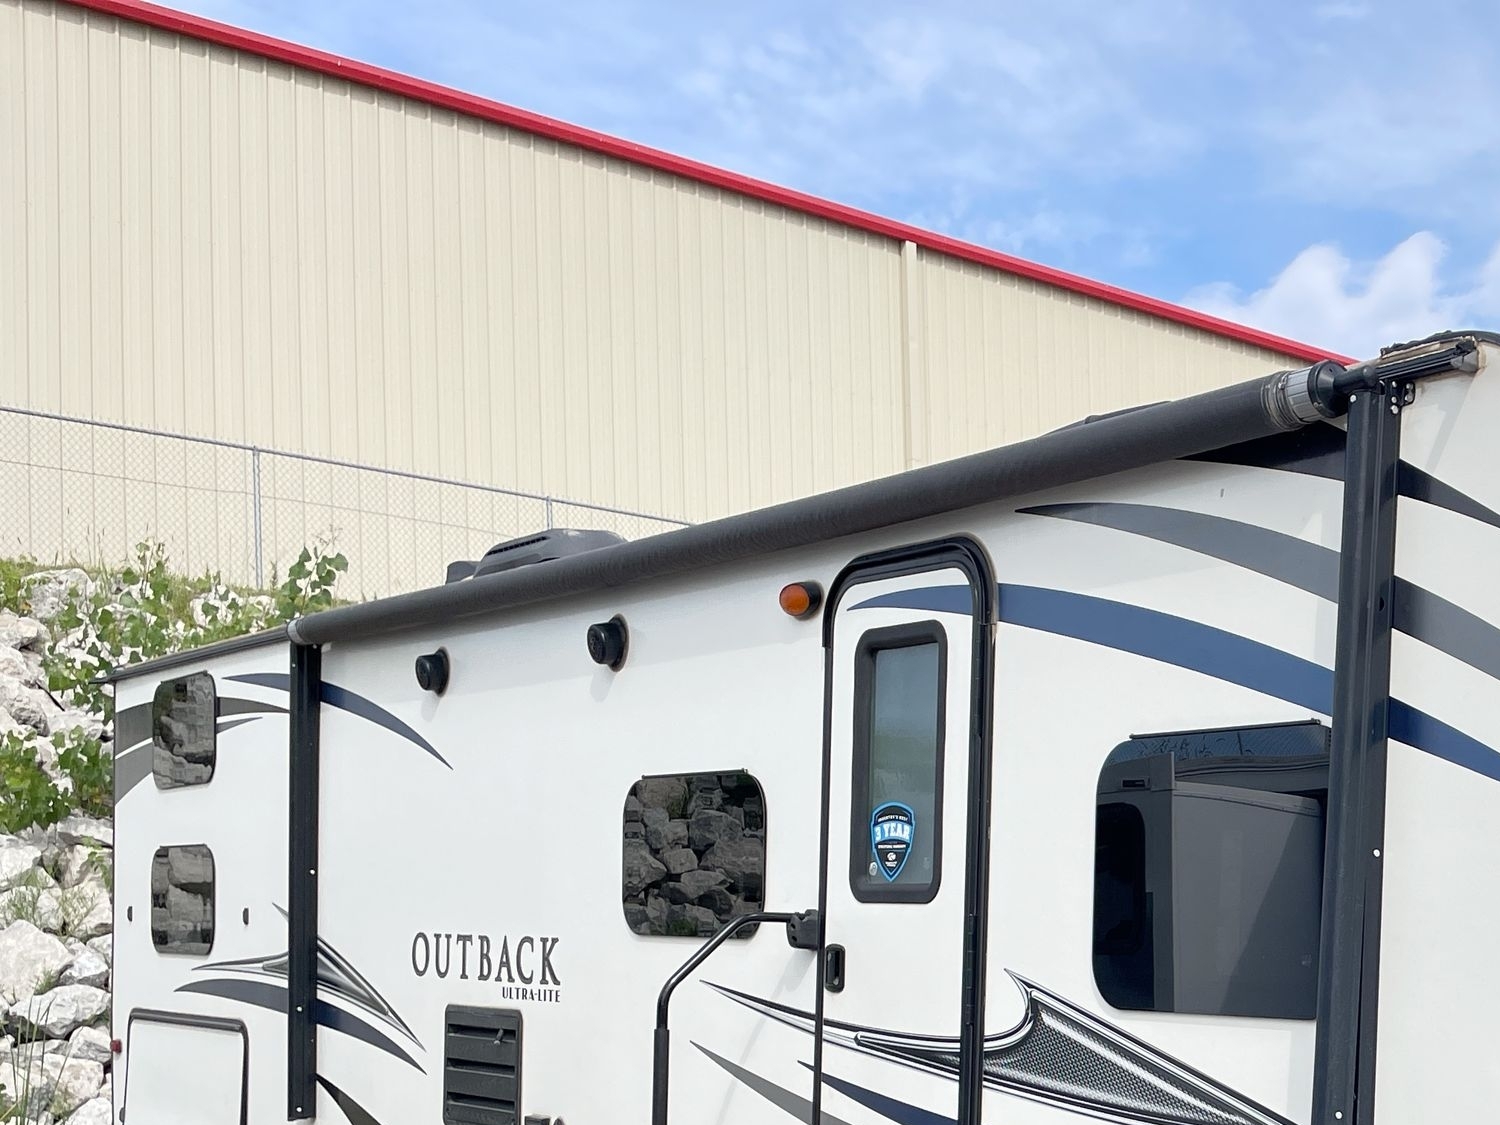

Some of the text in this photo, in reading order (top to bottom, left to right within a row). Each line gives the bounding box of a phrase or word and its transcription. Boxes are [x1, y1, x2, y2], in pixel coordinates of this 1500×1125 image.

[875, 822, 911, 841] 3 YEAR
[412, 932, 561, 985] OUTBACK
[502, 986, 561, 1003] ULTRA-LITE
